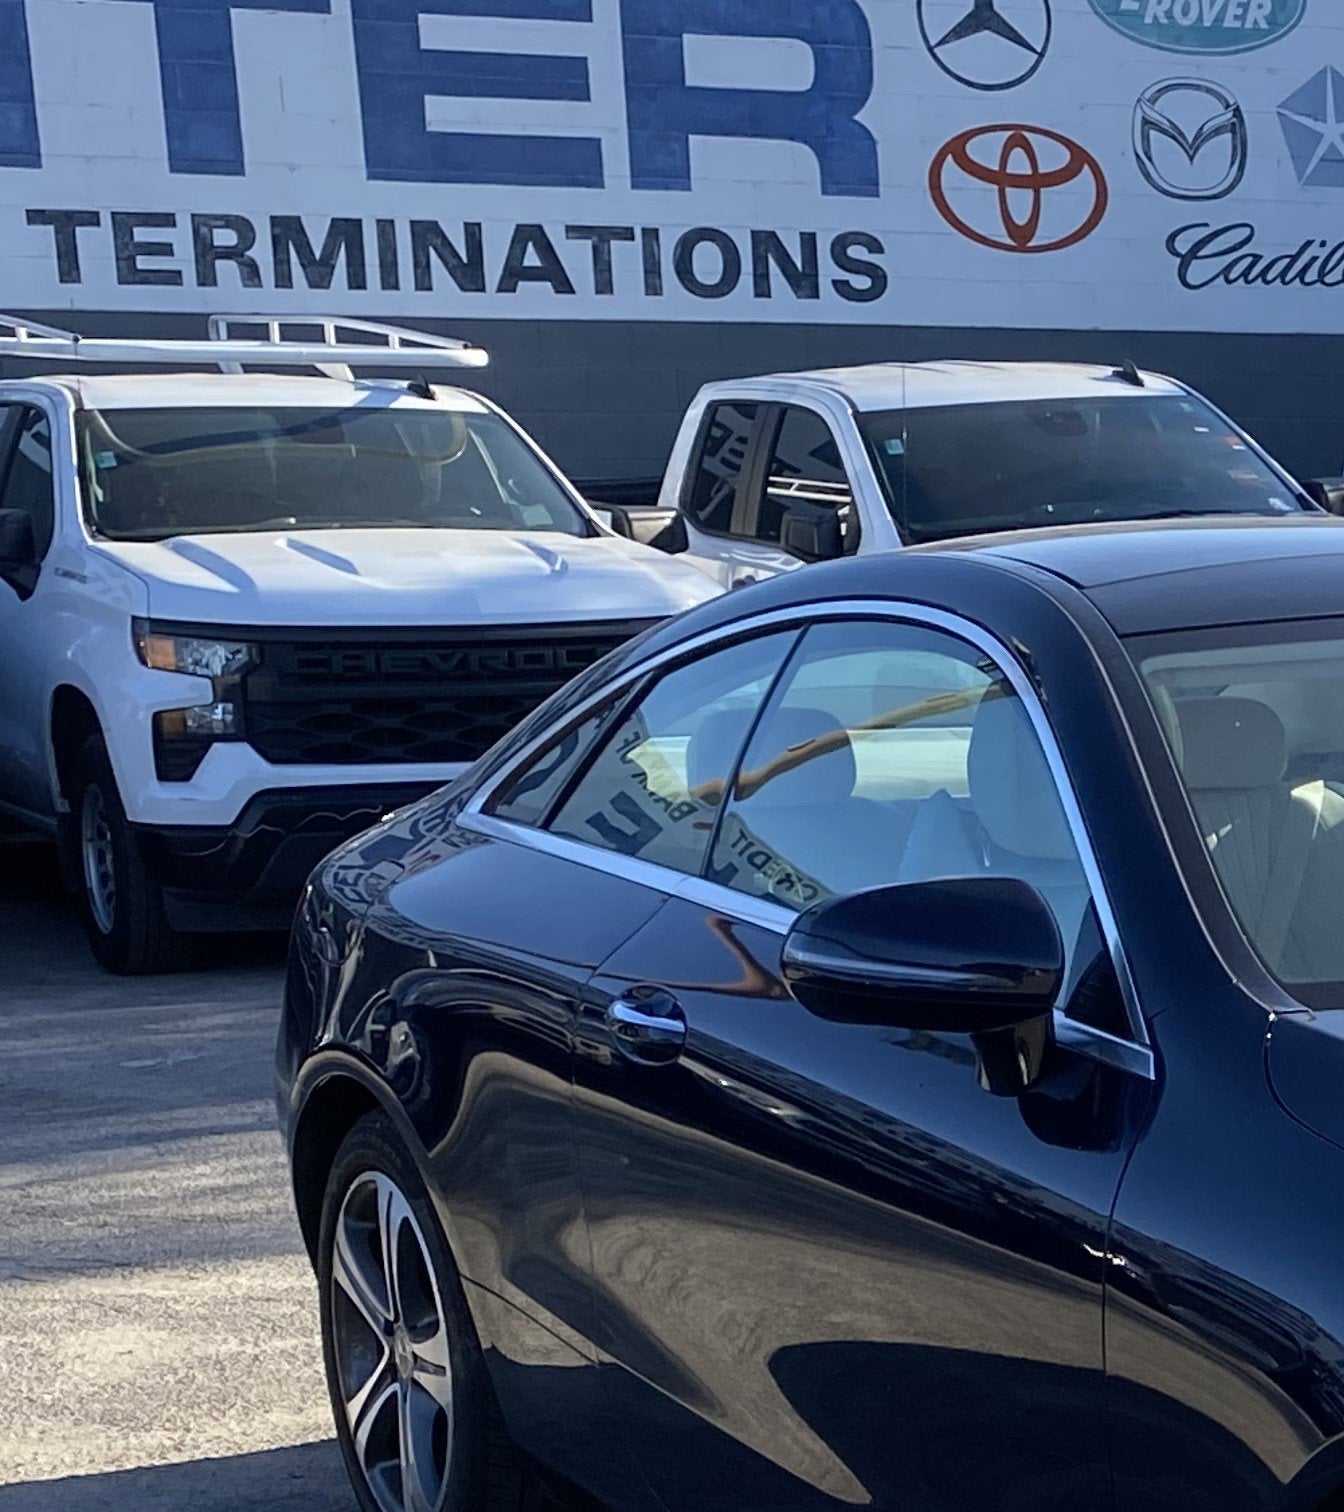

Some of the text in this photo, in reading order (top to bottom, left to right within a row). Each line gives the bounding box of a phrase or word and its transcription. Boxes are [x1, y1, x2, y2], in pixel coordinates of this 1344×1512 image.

[1143, 0, 1272, 29] ROVER
[0, 0, 881, 198] TER
[26, 208, 889, 303] TERMINATIONS
